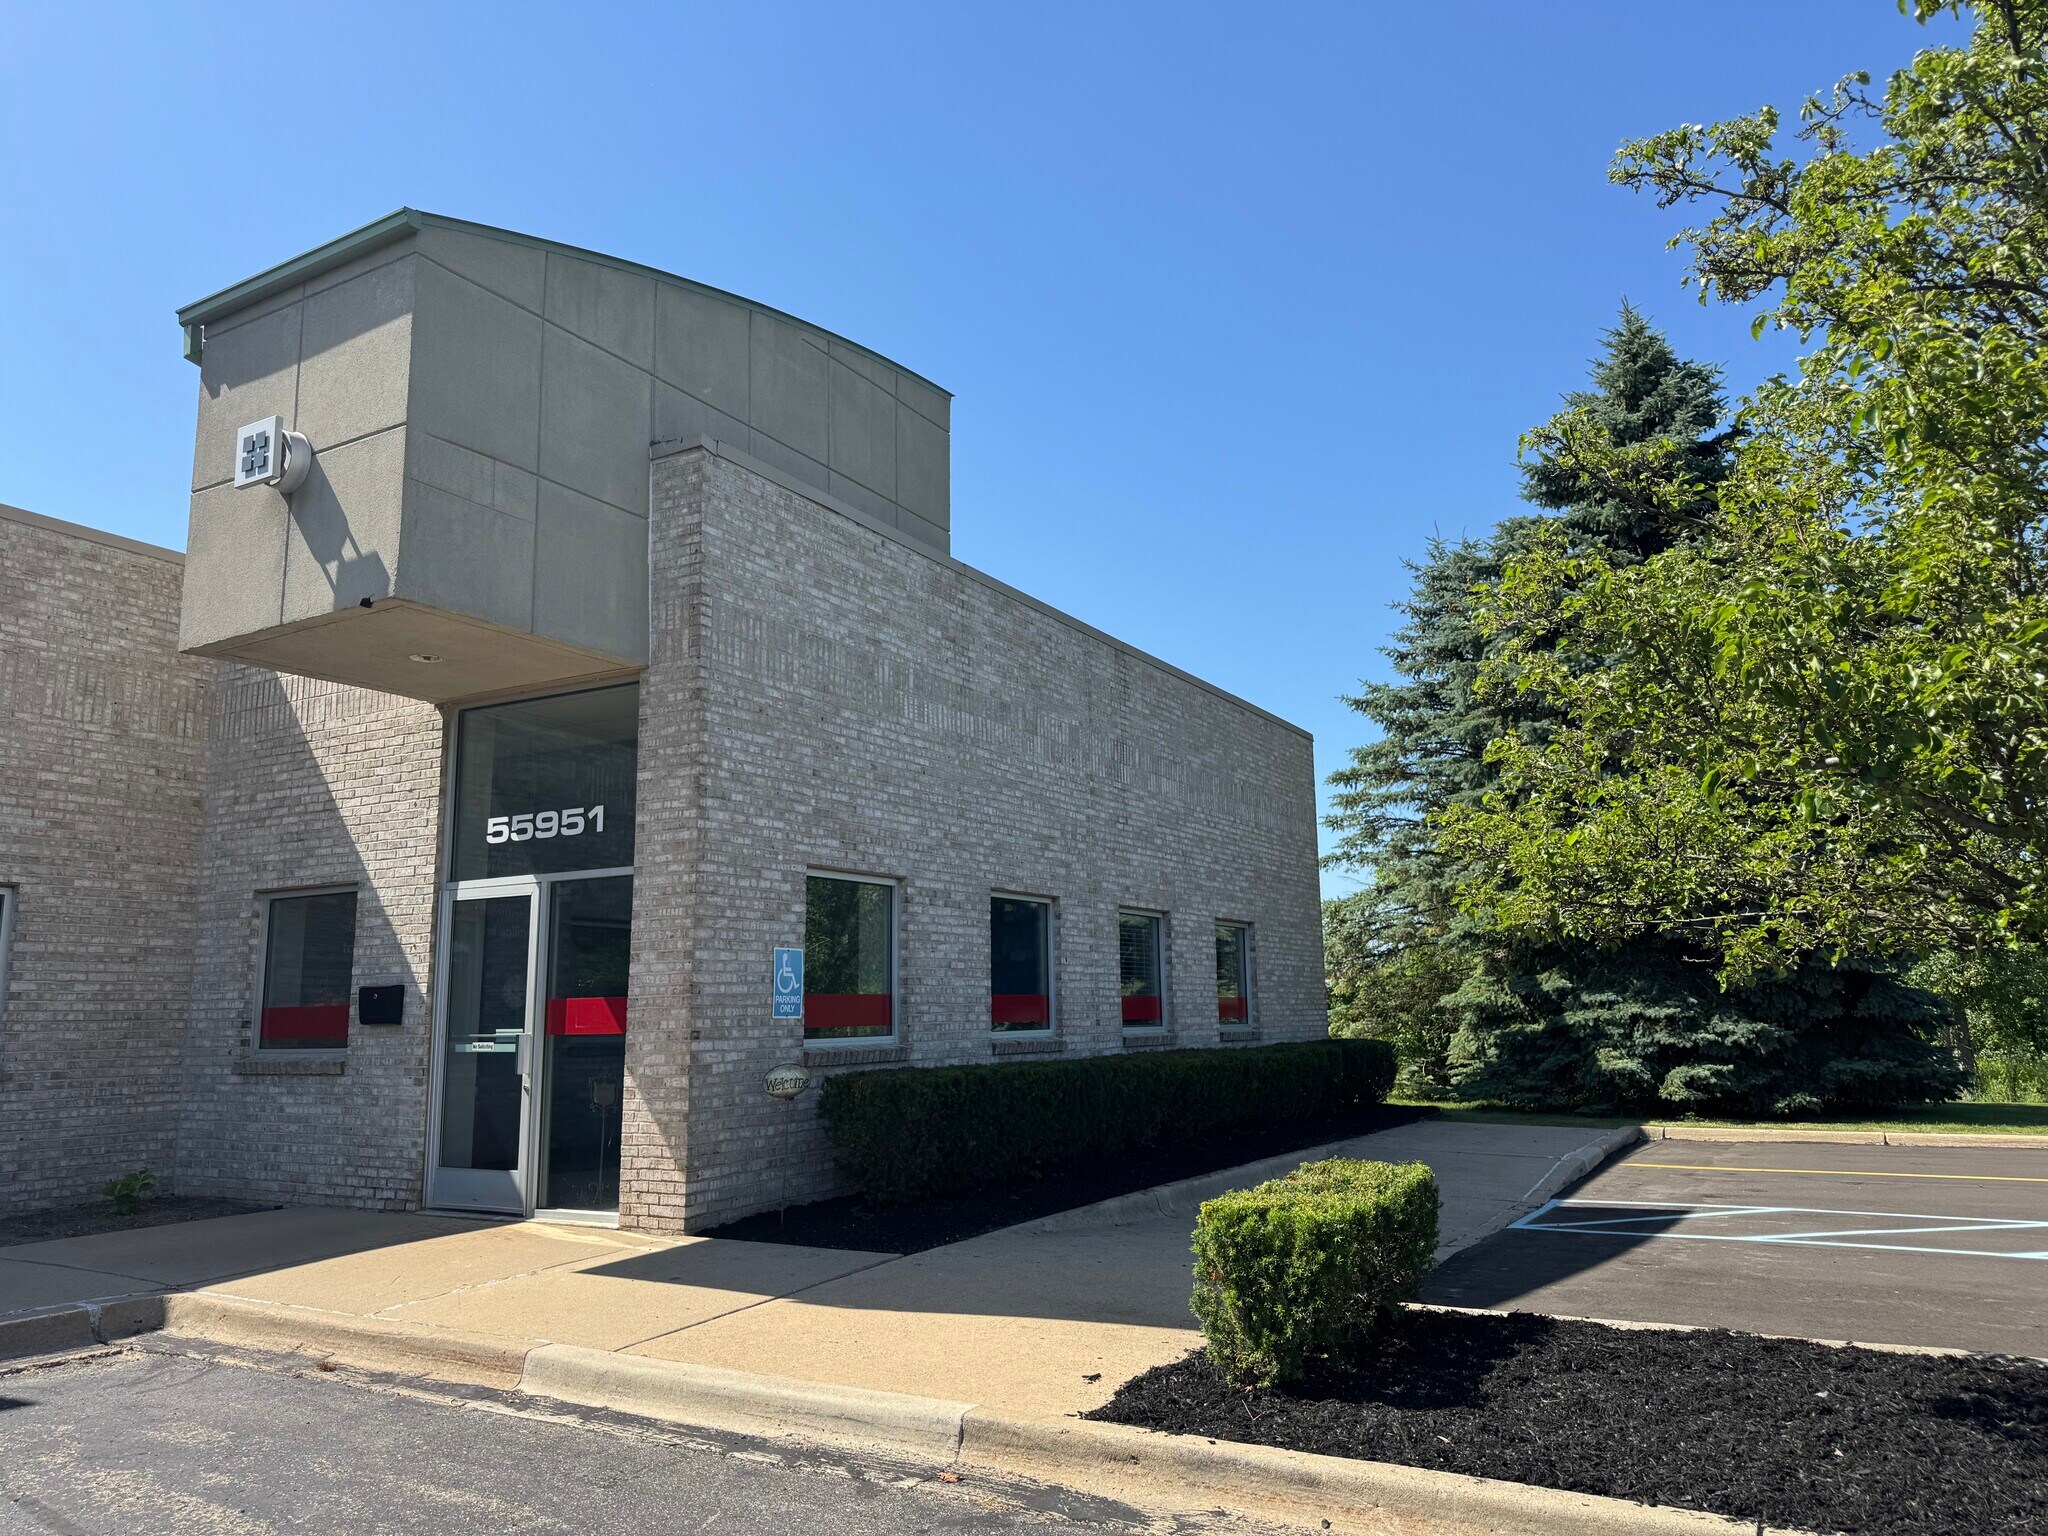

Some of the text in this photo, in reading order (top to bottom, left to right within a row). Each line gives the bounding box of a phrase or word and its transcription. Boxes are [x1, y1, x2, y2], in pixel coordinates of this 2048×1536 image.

[486, 804, 604, 844] 55951
[775, 995, 800, 1004] PARKING
[780, 1004, 795, 1013] ONLY
[765, 1077, 810, 1091] Welcome
